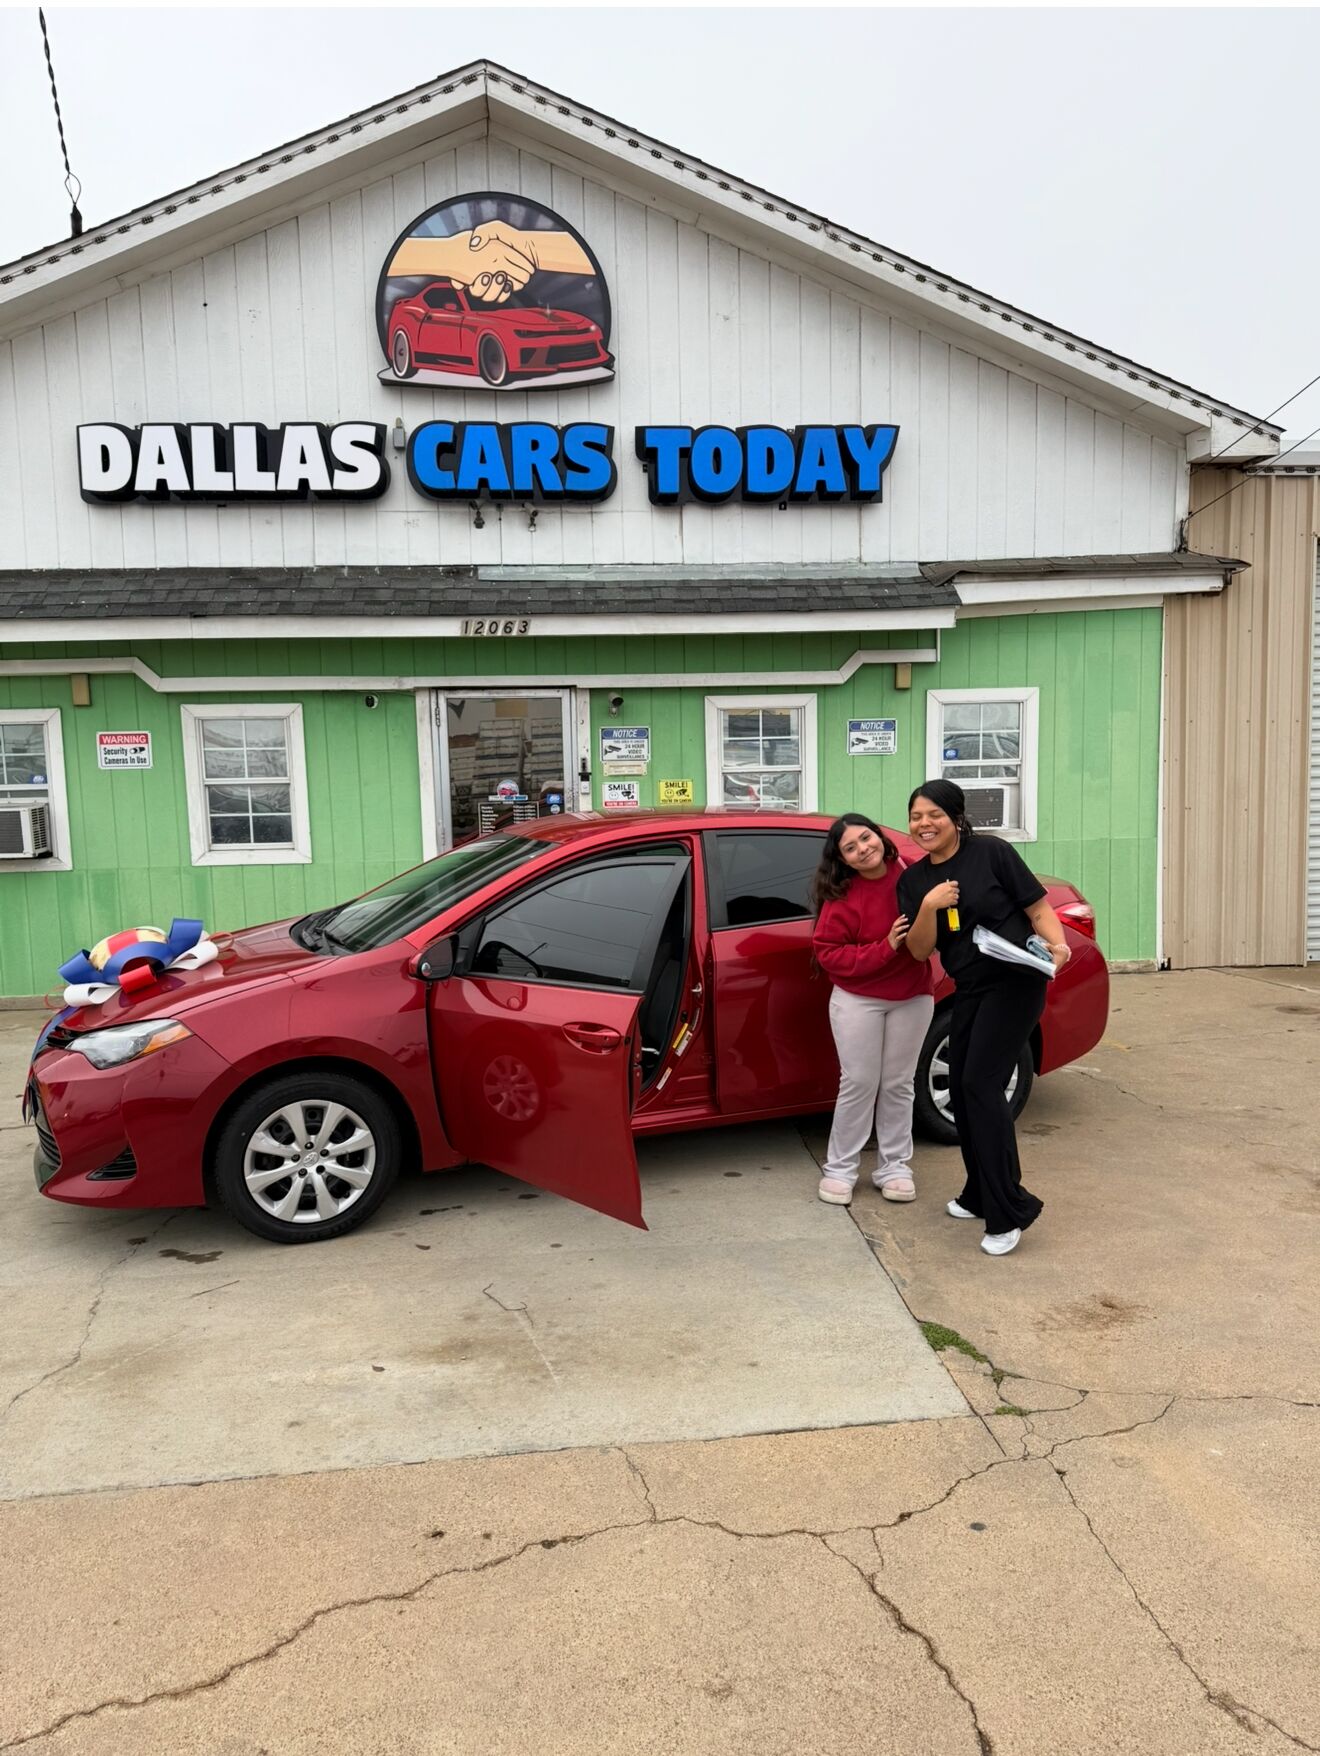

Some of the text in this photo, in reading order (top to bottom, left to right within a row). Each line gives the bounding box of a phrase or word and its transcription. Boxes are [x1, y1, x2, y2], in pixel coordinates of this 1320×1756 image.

[78, 422, 897, 494] DALLAS CARS TODAY
[464, 620, 529, 634] 12063
[860, 721, 885, 730] NOTICE
[612, 729, 638, 738] NOTICE
[101, 734, 147, 744] WARNING
[103, 747, 128, 756] Security
[104, 756, 147, 765] Cameras In Use
[607, 783, 635, 793] SMILE!
